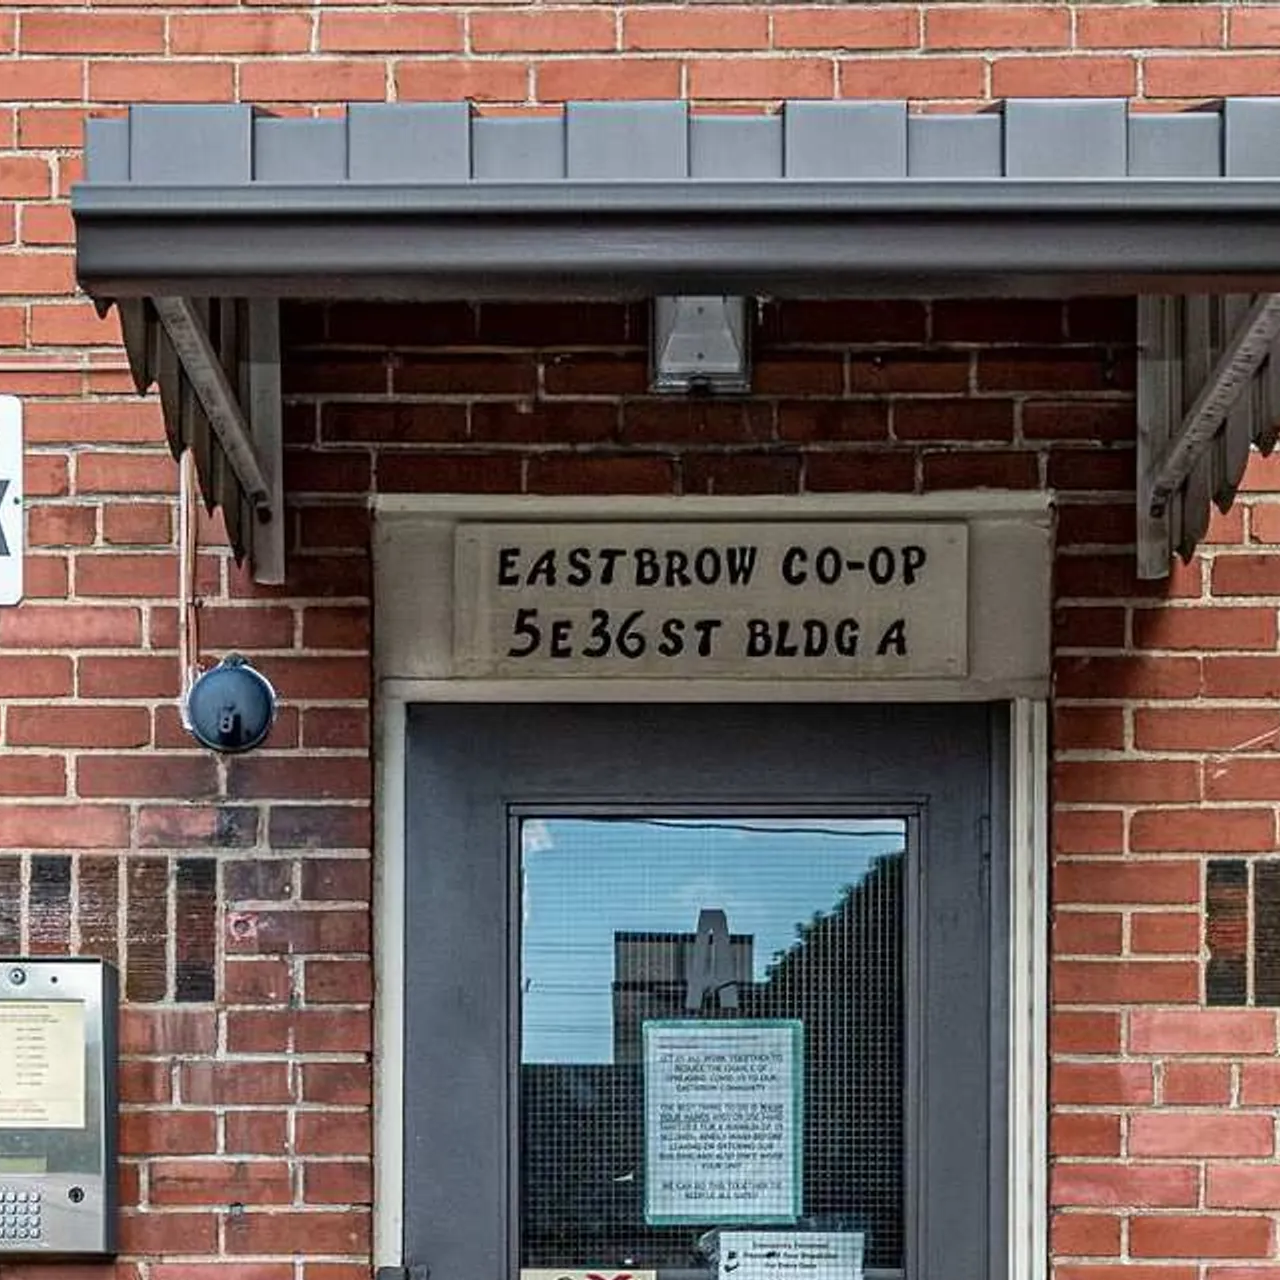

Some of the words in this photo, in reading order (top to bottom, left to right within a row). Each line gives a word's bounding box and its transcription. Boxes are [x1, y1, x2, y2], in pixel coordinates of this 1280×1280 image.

[497, 545, 759, 588] EASTBROW
[781, 545, 928, 588] CO-OP
[745, 617, 861, 659] BLDG
[874, 617, 909, 657] A
